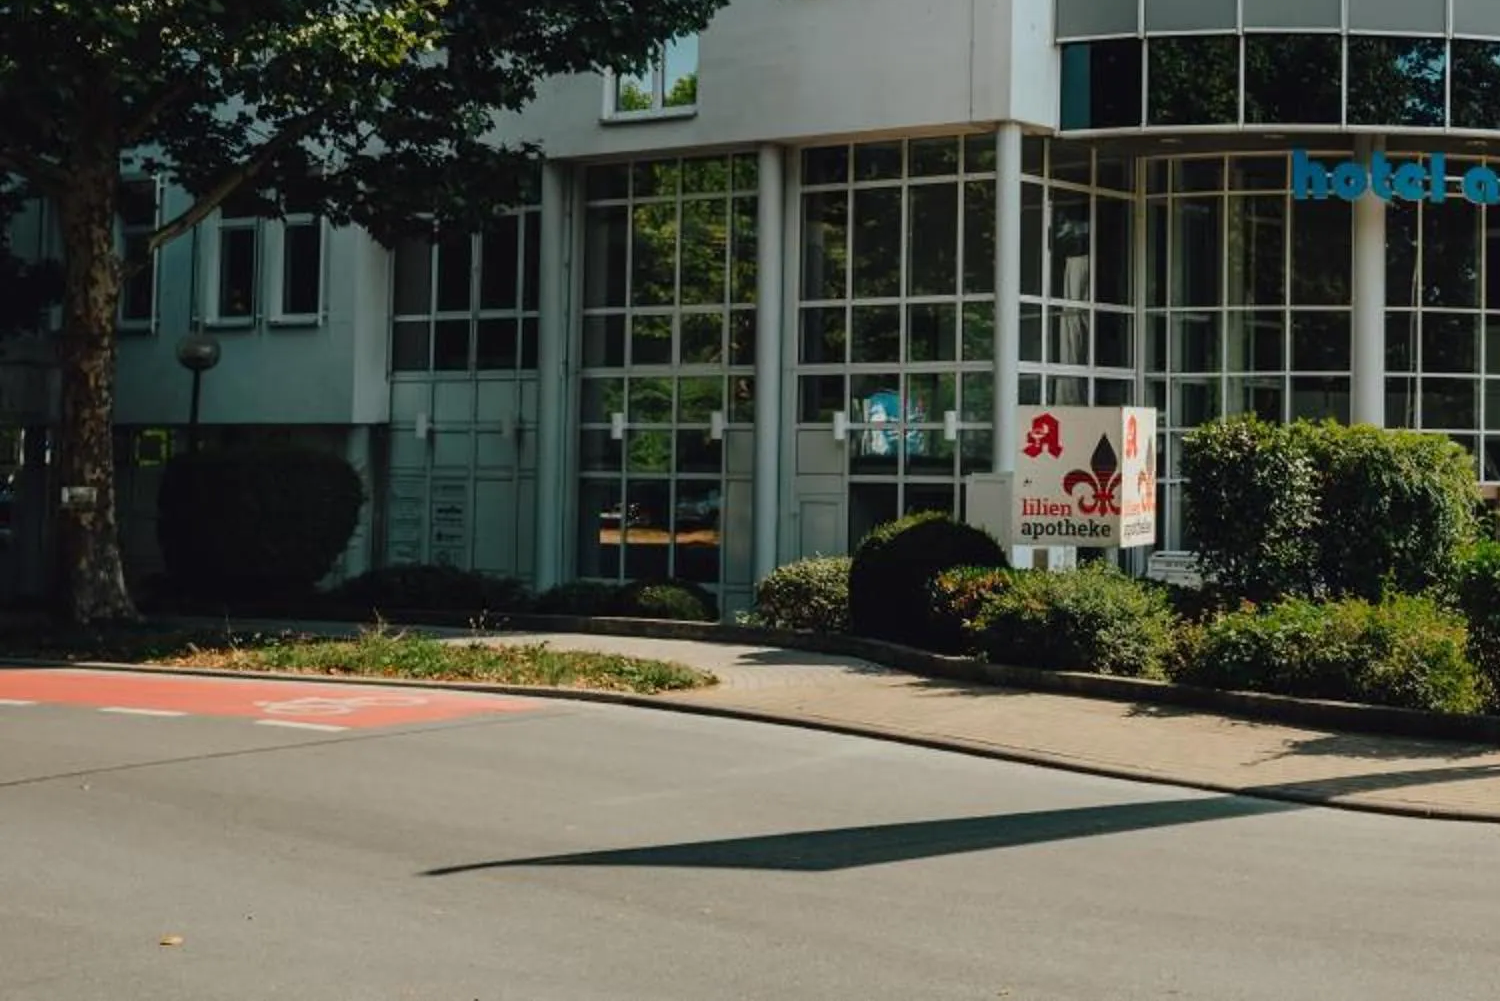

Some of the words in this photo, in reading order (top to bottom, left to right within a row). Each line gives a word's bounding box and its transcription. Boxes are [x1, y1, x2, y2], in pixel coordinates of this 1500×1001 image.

[1292, 148, 1447, 204] hotel
[1022, 498, 1073, 516] lilien
[1021, 518, 1112, 540] apotheke
